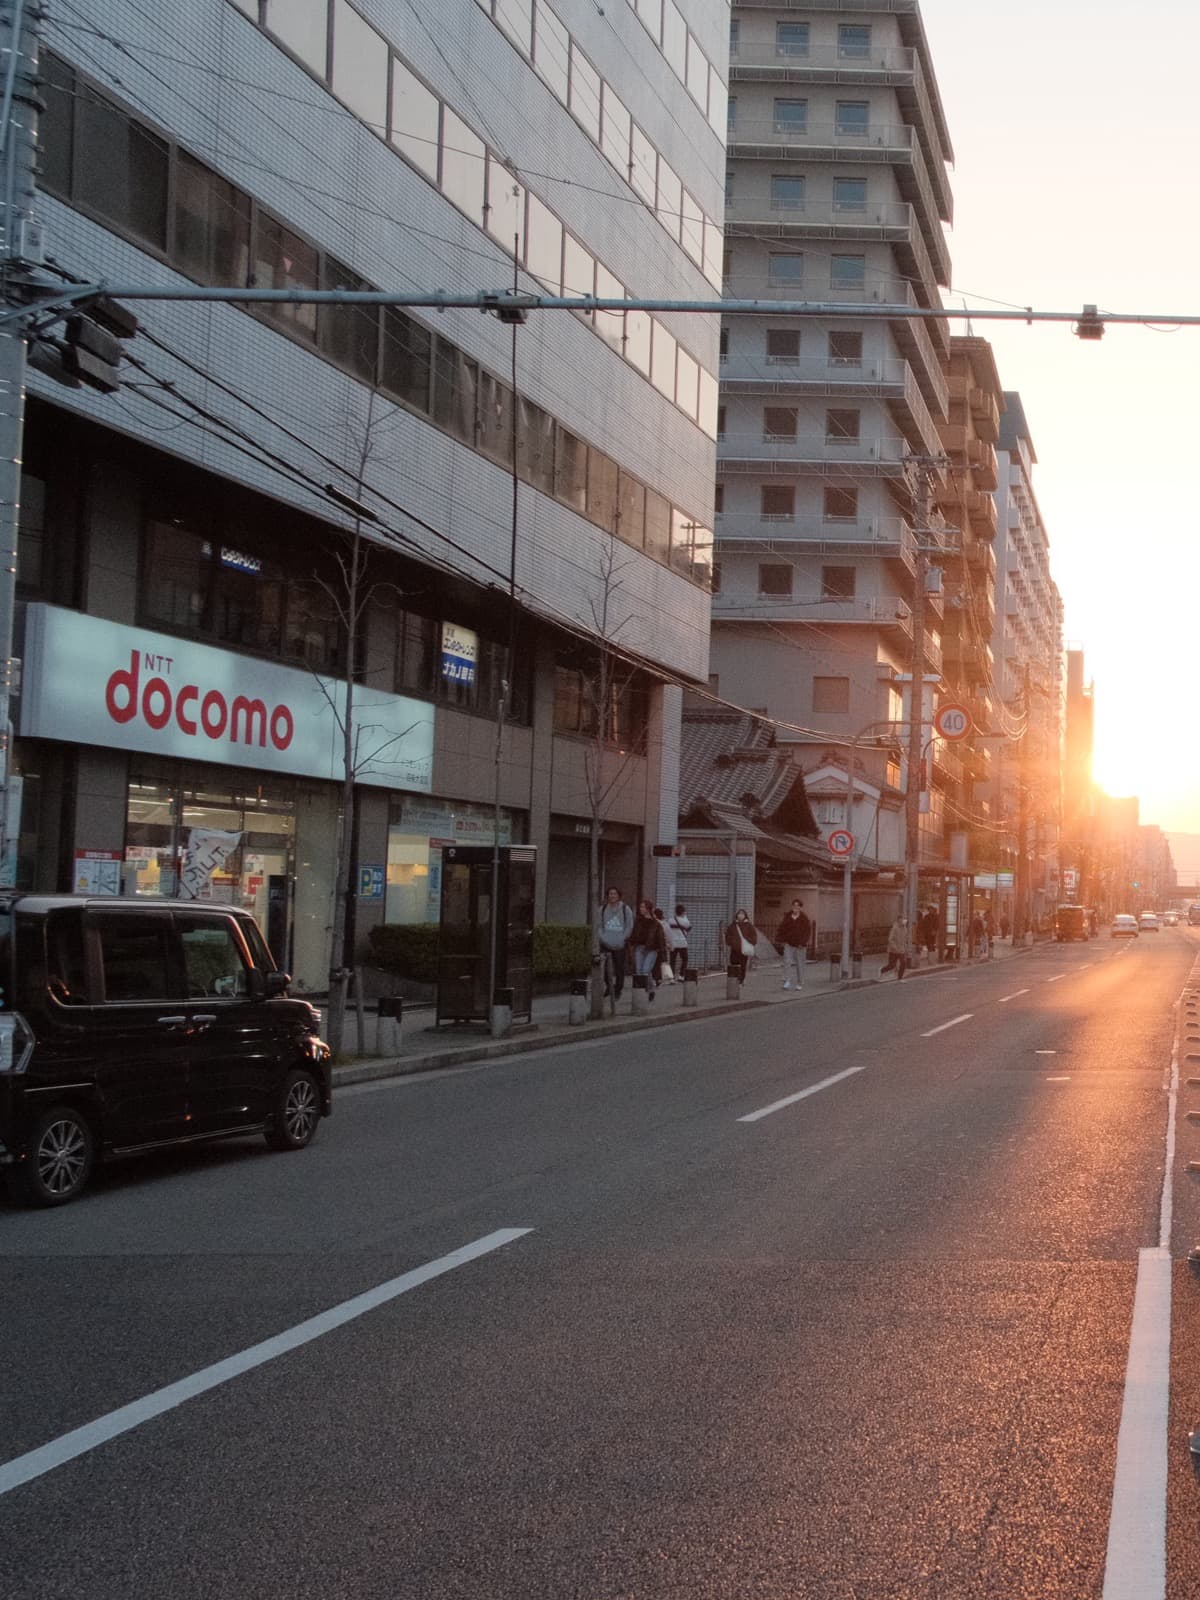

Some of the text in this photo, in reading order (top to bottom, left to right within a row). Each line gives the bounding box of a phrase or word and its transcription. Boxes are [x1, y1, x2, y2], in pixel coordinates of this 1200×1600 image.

[144, 653, 174, 674] NTT
[105, 649, 295, 751] docomo
[943, 714, 963, 730] 40
